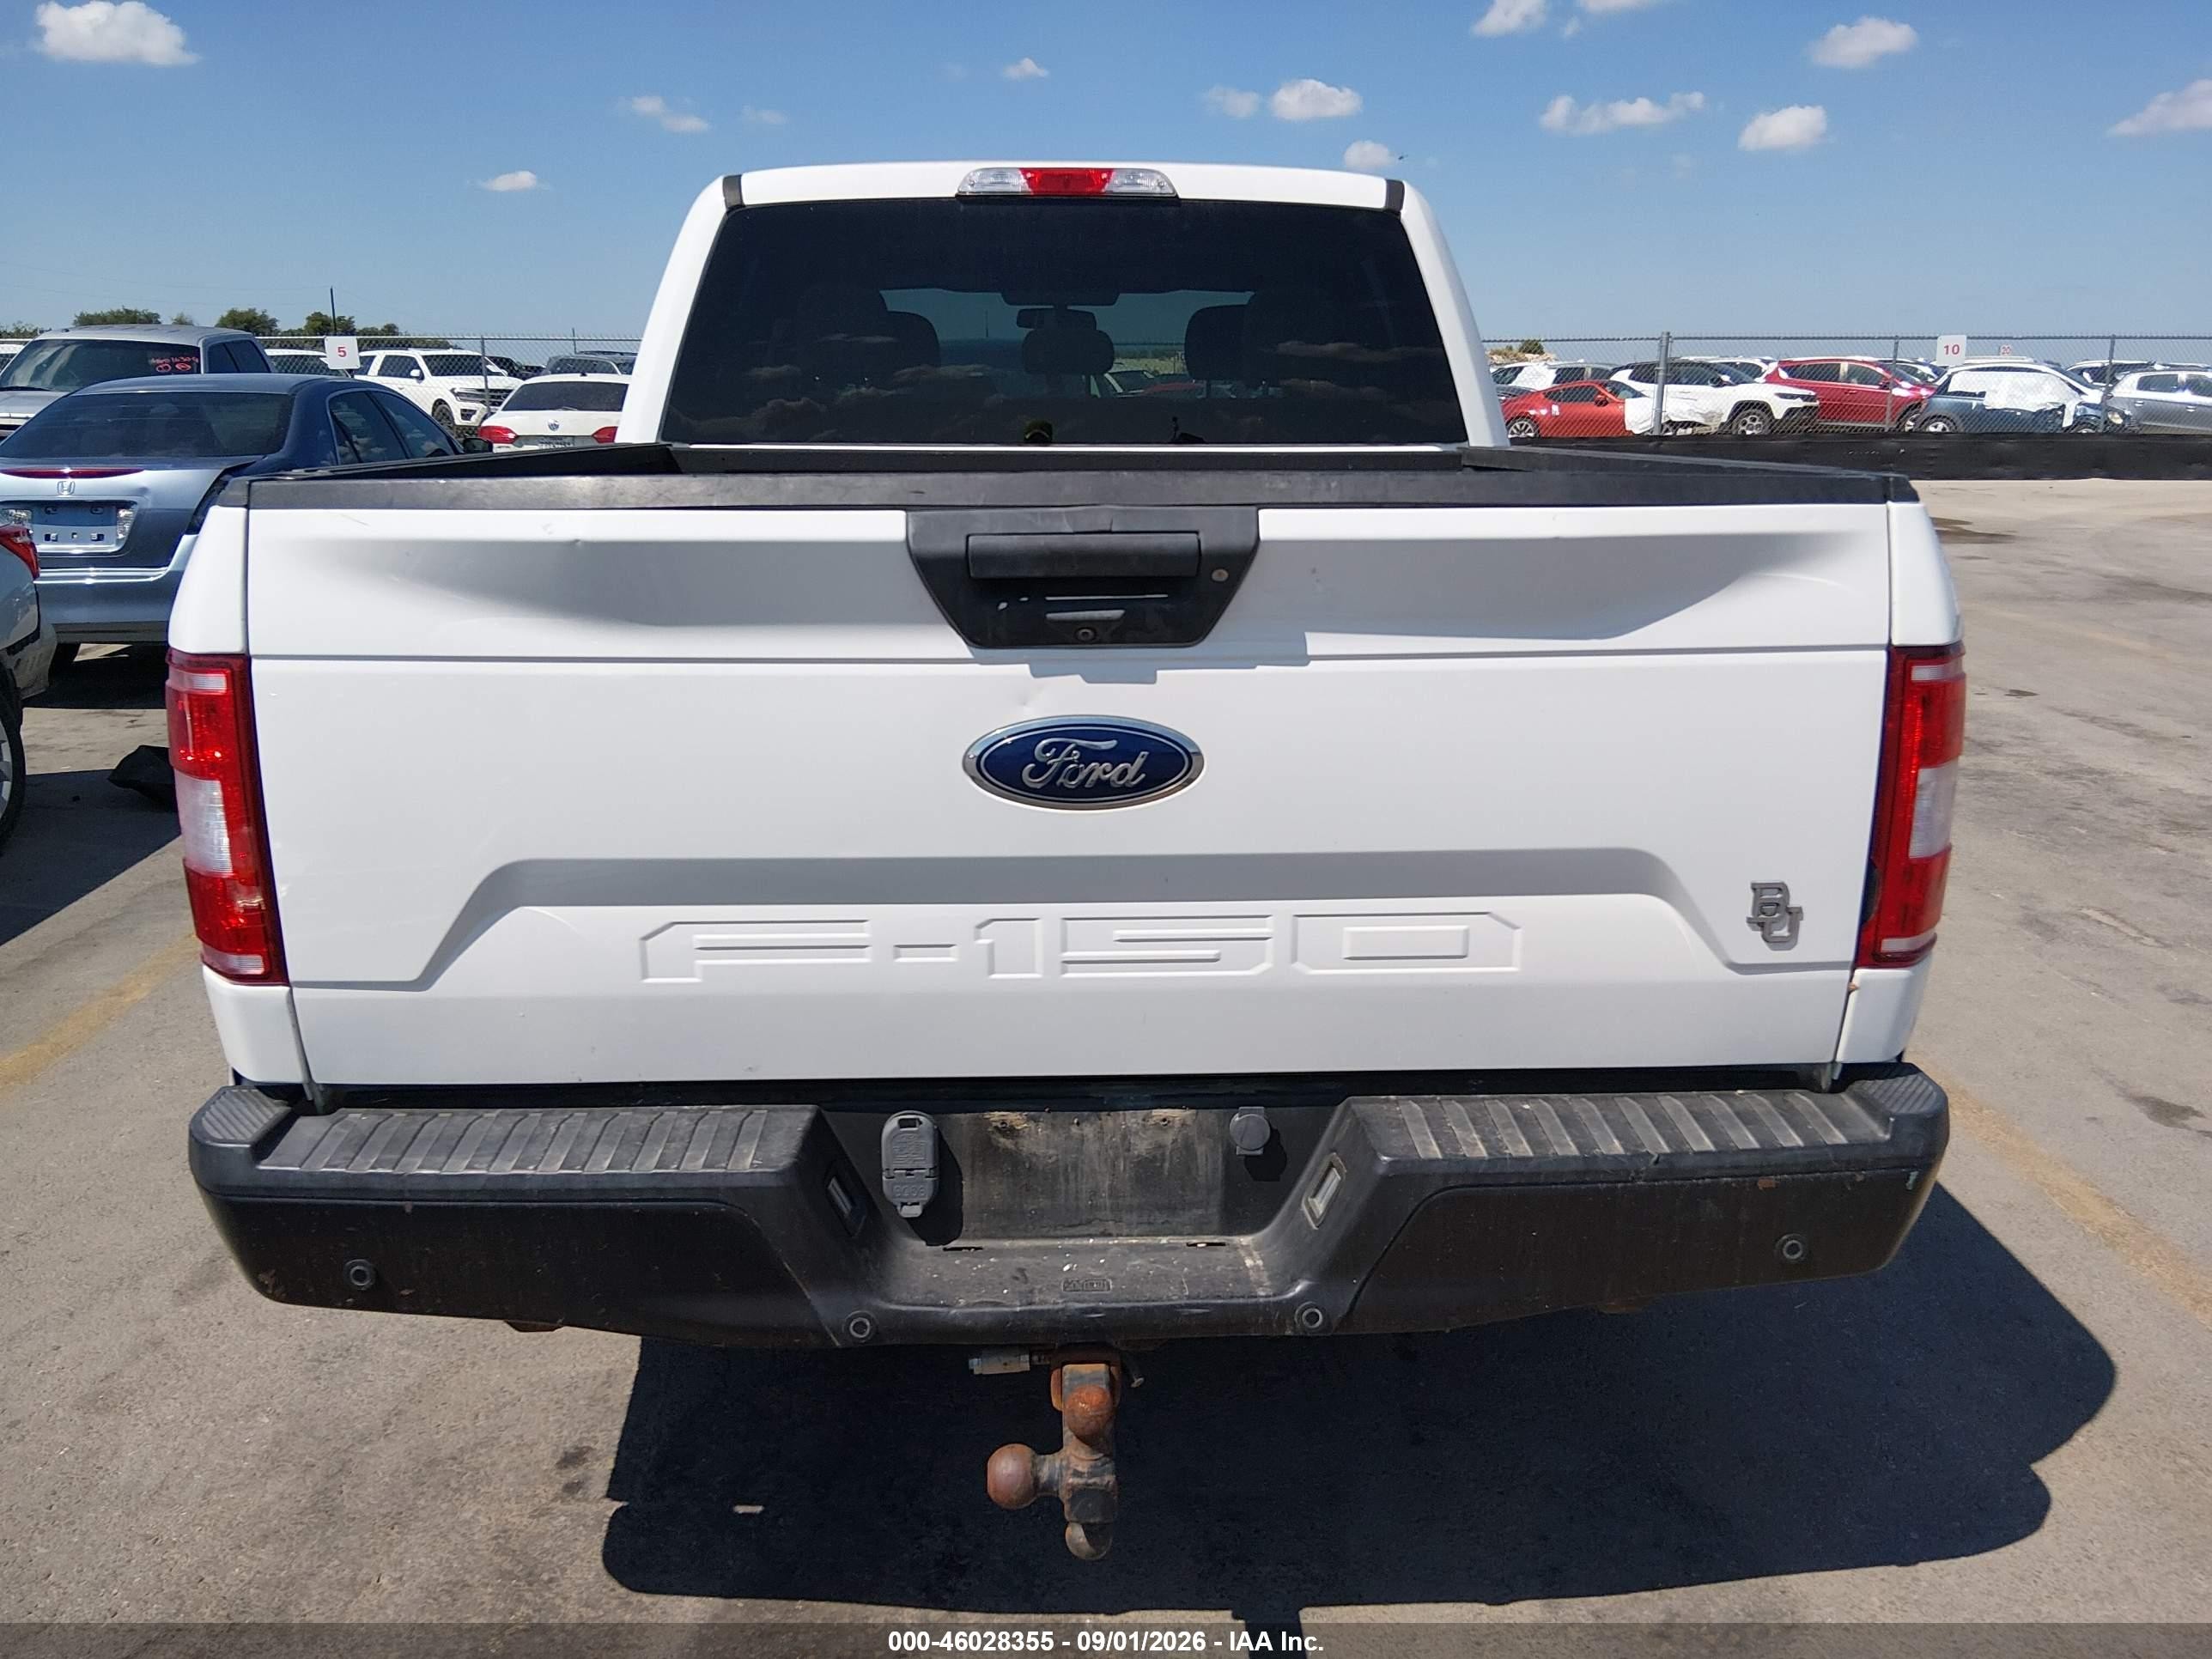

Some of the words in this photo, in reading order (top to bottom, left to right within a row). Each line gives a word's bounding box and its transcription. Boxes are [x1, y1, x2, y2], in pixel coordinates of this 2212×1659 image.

[337, 346, 347, 358] 5
[1943, 343, 1960, 356] 10
[1021, 737, 1149, 788] Ford
[641, 911, 1523, 983] F-150
